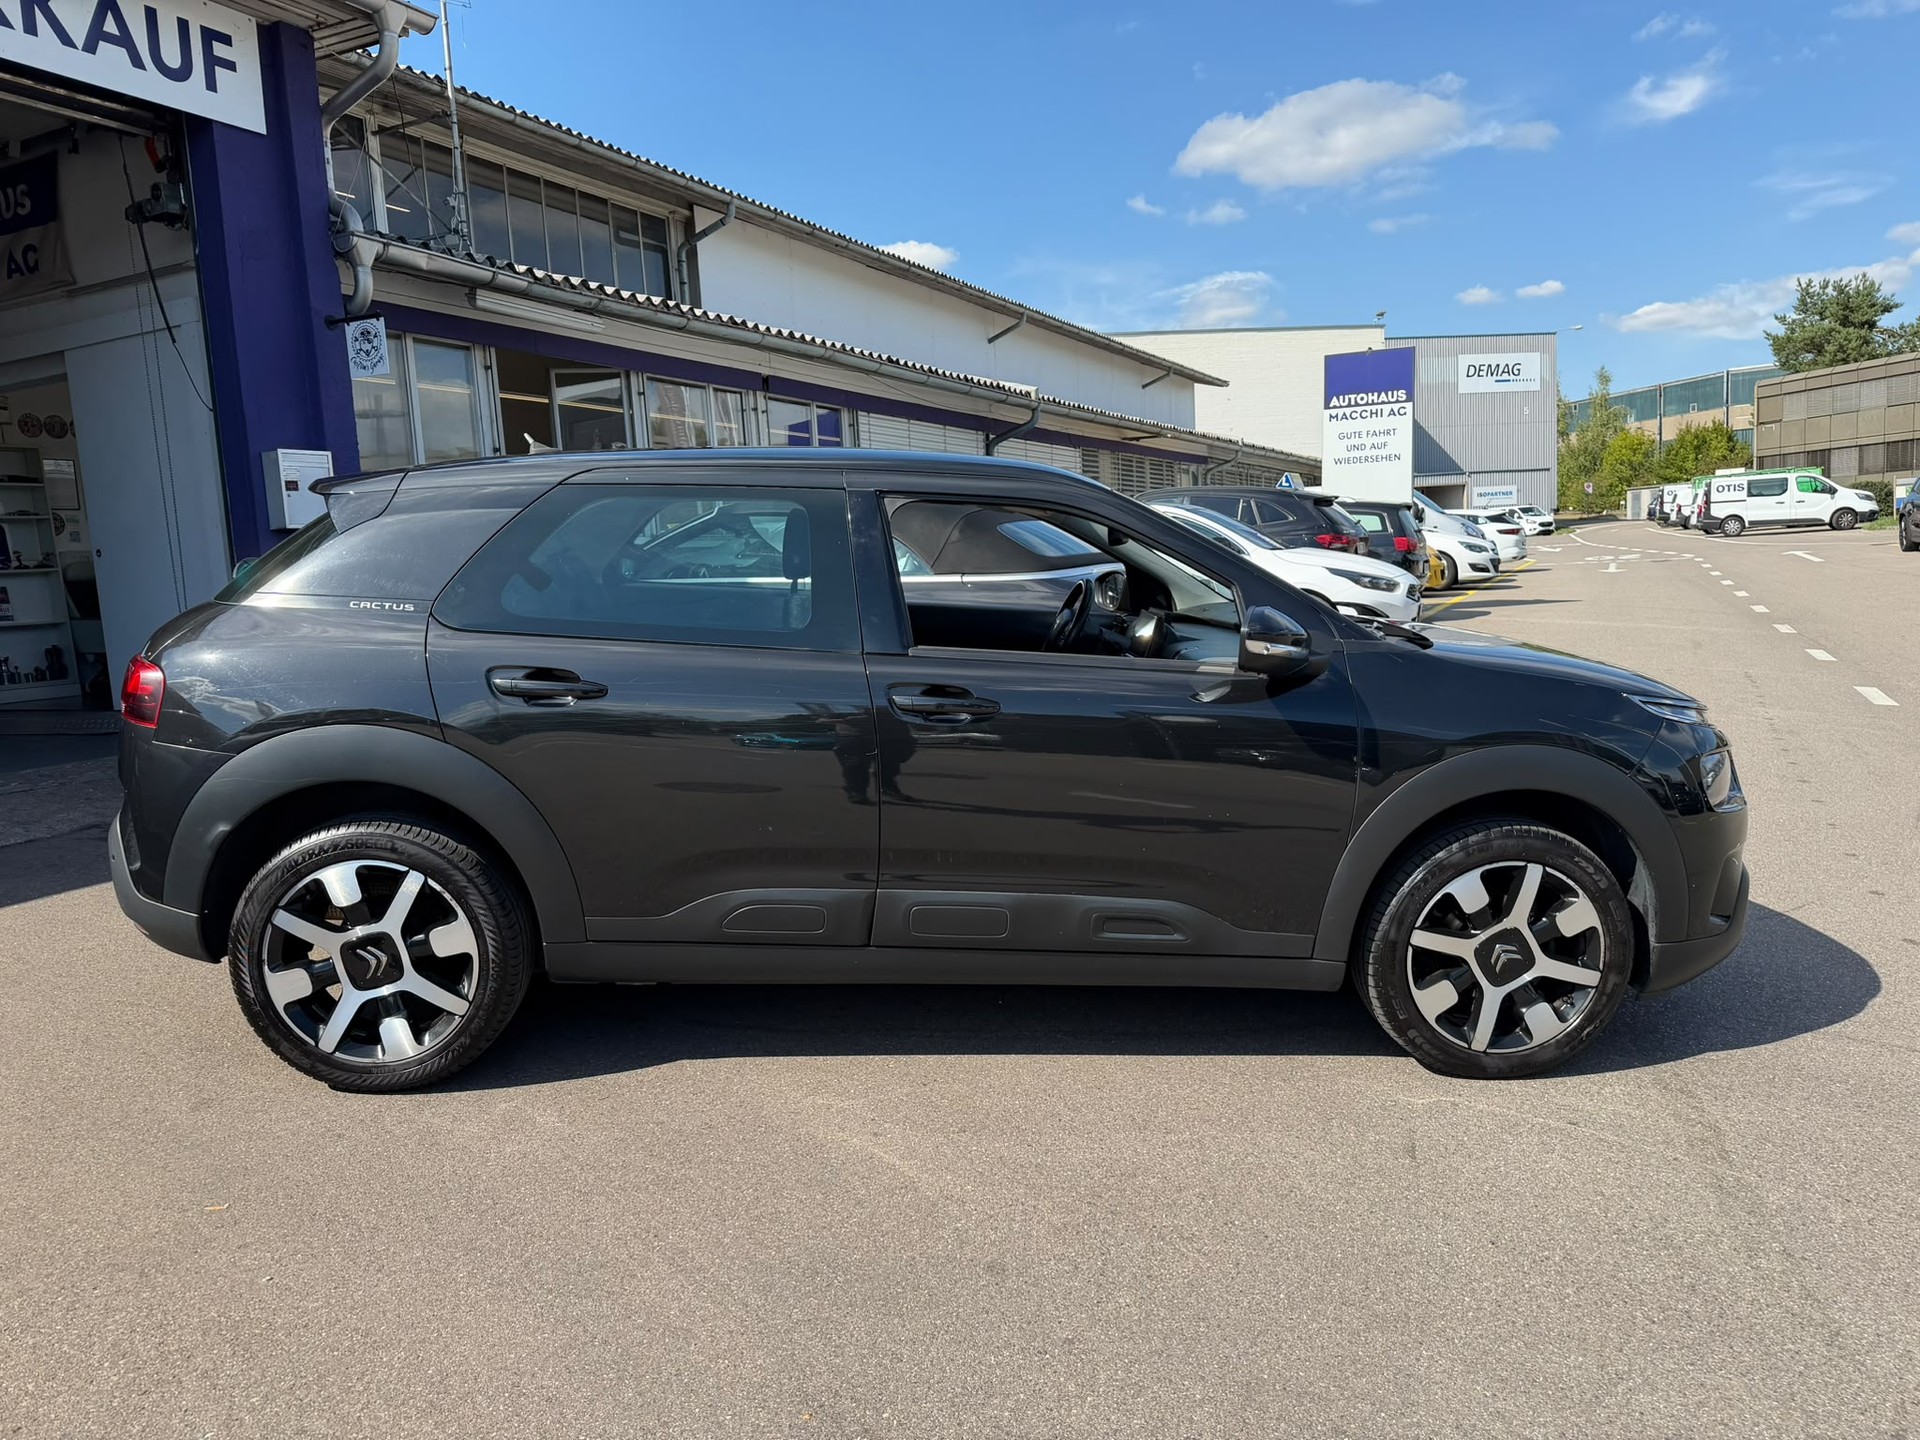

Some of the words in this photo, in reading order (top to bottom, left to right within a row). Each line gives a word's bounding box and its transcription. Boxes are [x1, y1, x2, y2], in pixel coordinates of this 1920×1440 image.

[0, 0, 237, 94] KAUF
[6, 243, 40, 280] AG
[1466, 362, 1522, 378] DEMAG
[1329, 389, 1408, 408] AUTOHAUS
[1328, 408, 1384, 423] MACCHI
[1387, 406, 1408, 418] AG
[1338, 431, 1363, 441] GUTE
[1366, 428, 1398, 439] FAHRT
[1346, 443, 1367, 453] UND
[1369, 441, 1389, 451] AUF
[1333, 453, 1401, 466] WIEDERSEHEN
[1716, 483, 1745, 493] OTIS
[349, 600, 415, 611] CACTUS
